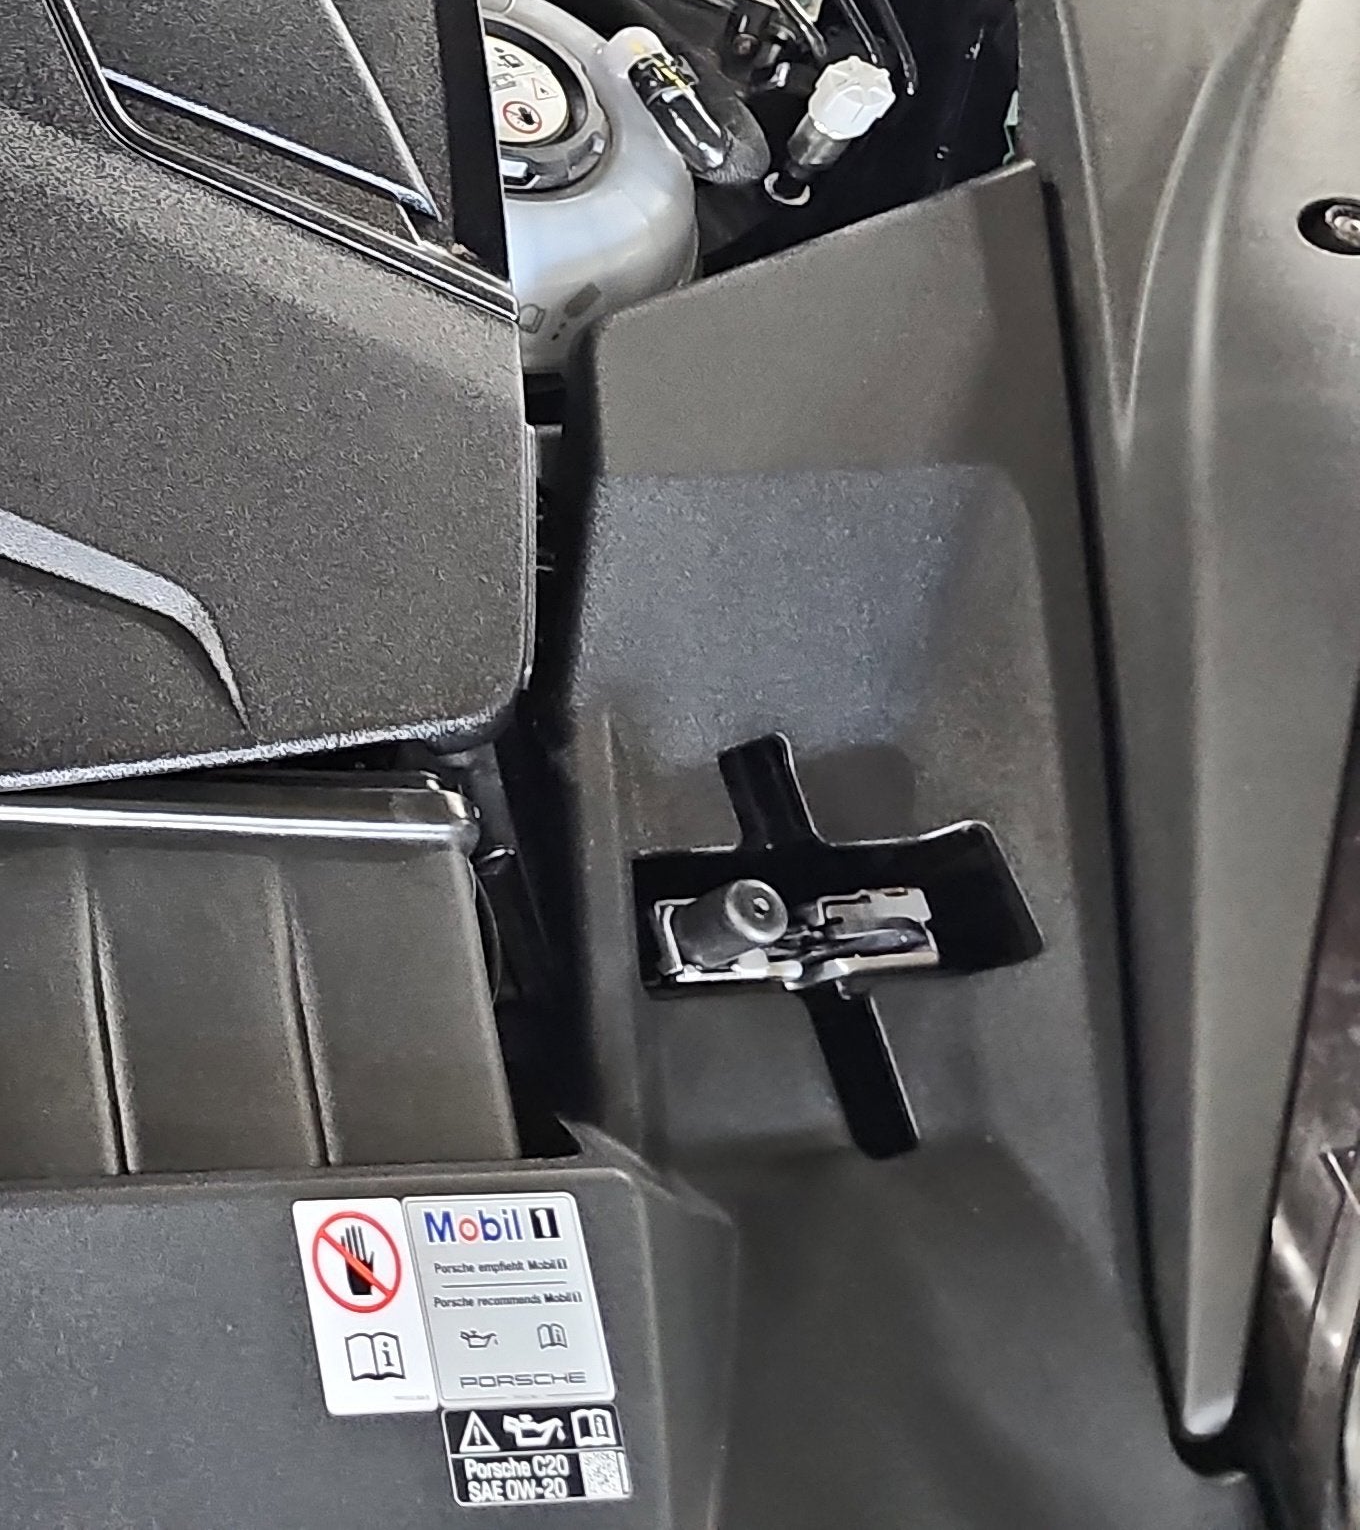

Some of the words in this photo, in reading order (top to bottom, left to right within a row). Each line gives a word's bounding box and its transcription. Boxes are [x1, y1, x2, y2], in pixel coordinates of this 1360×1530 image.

[423, 1208, 523, 1243] Mobil
[434, 1263, 475, 1274] Porsche
[434, 1296, 474, 1308] Porsche
[478, 1294, 541, 1307] recommends
[460, 1372, 587, 1388] PORSCHE
[464, 1456, 531, 1480] Porsche
[532, 1454, 570, 1477] C20
[468, 1480, 505, 1503] SAE
[506, 1478, 568, 1501] 0W-20
